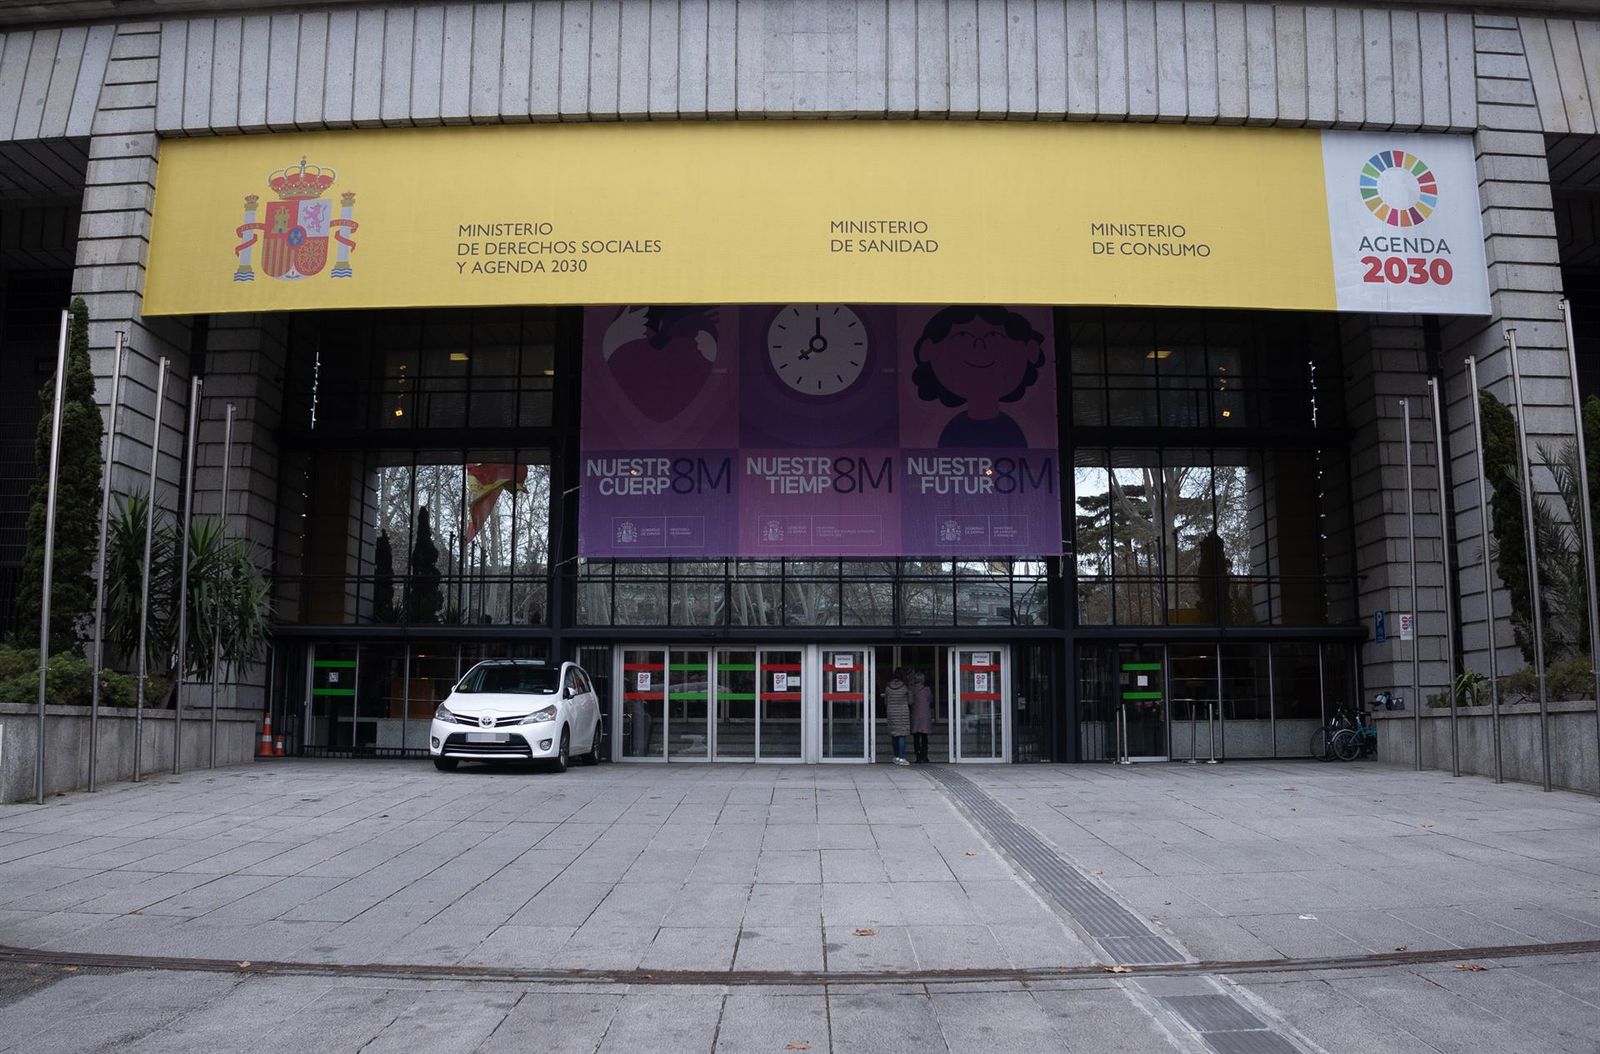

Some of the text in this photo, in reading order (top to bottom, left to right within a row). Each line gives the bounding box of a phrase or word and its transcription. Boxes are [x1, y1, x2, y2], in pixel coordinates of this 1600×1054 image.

[458, 222, 553, 237] MINISTERIO
[830, 220, 928, 234] MINISTERIO
[1091, 223, 1186, 238] MINISTERIO
[457, 239, 662, 256] DE DERECHOS SOCIALES
[830, 239, 939, 253] DE SANIDAD
[1092, 241, 1211, 258] DE CONSUMO
[1359, 235, 1452, 255] AGENDA
[456, 259, 588, 275] Y AGENDA 2030
[1361, 255, 1454, 286] 2030
[599, 477, 671, 495] CUERP
[766, 476, 832, 494] TIEMP
[921, 476, 993, 494] FUTUR
